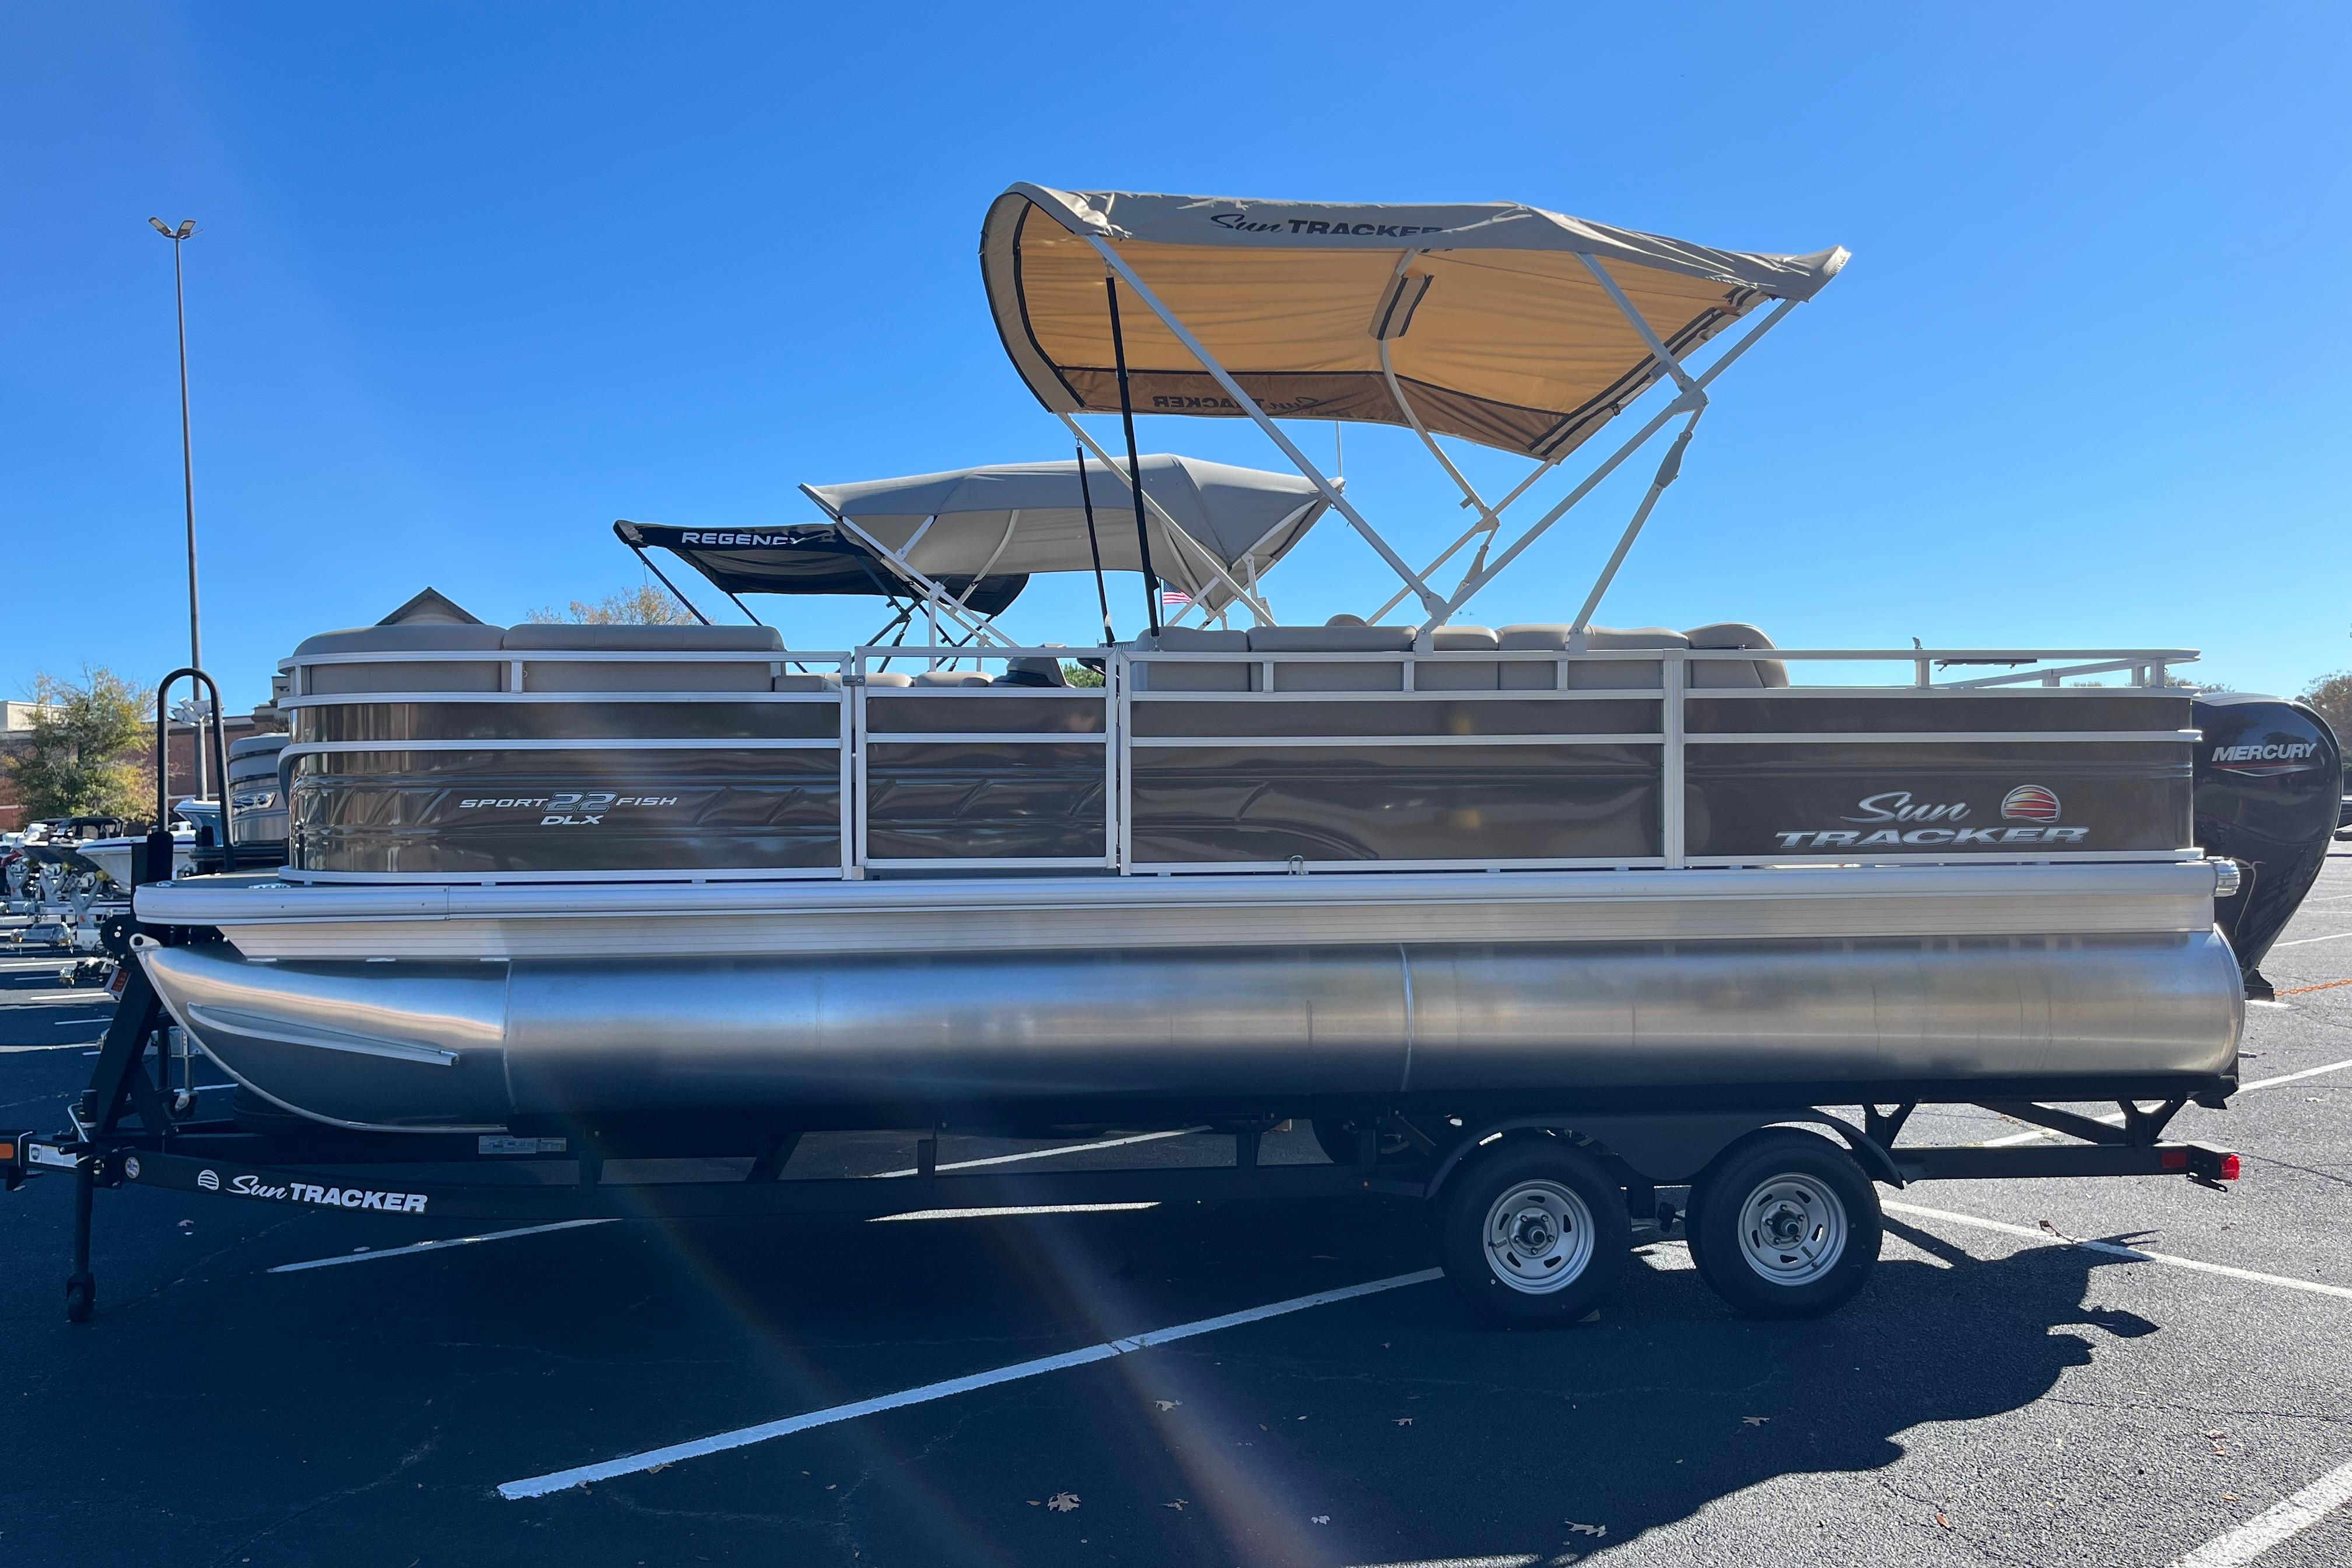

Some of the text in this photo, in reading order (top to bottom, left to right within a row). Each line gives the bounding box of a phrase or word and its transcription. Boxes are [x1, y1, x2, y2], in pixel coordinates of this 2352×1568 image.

[1210, 214, 1284, 233] Sun
[2211, 743, 2317, 762] MERCURY
[459, 791, 678, 813] SPORT 22 FISH
[1840, 790, 1972, 823] Sun
[540, 815, 604, 825] DLX
[1774, 826, 2090, 849] TRACKER
[226, 1175, 428, 1213] Sun TRACKER
